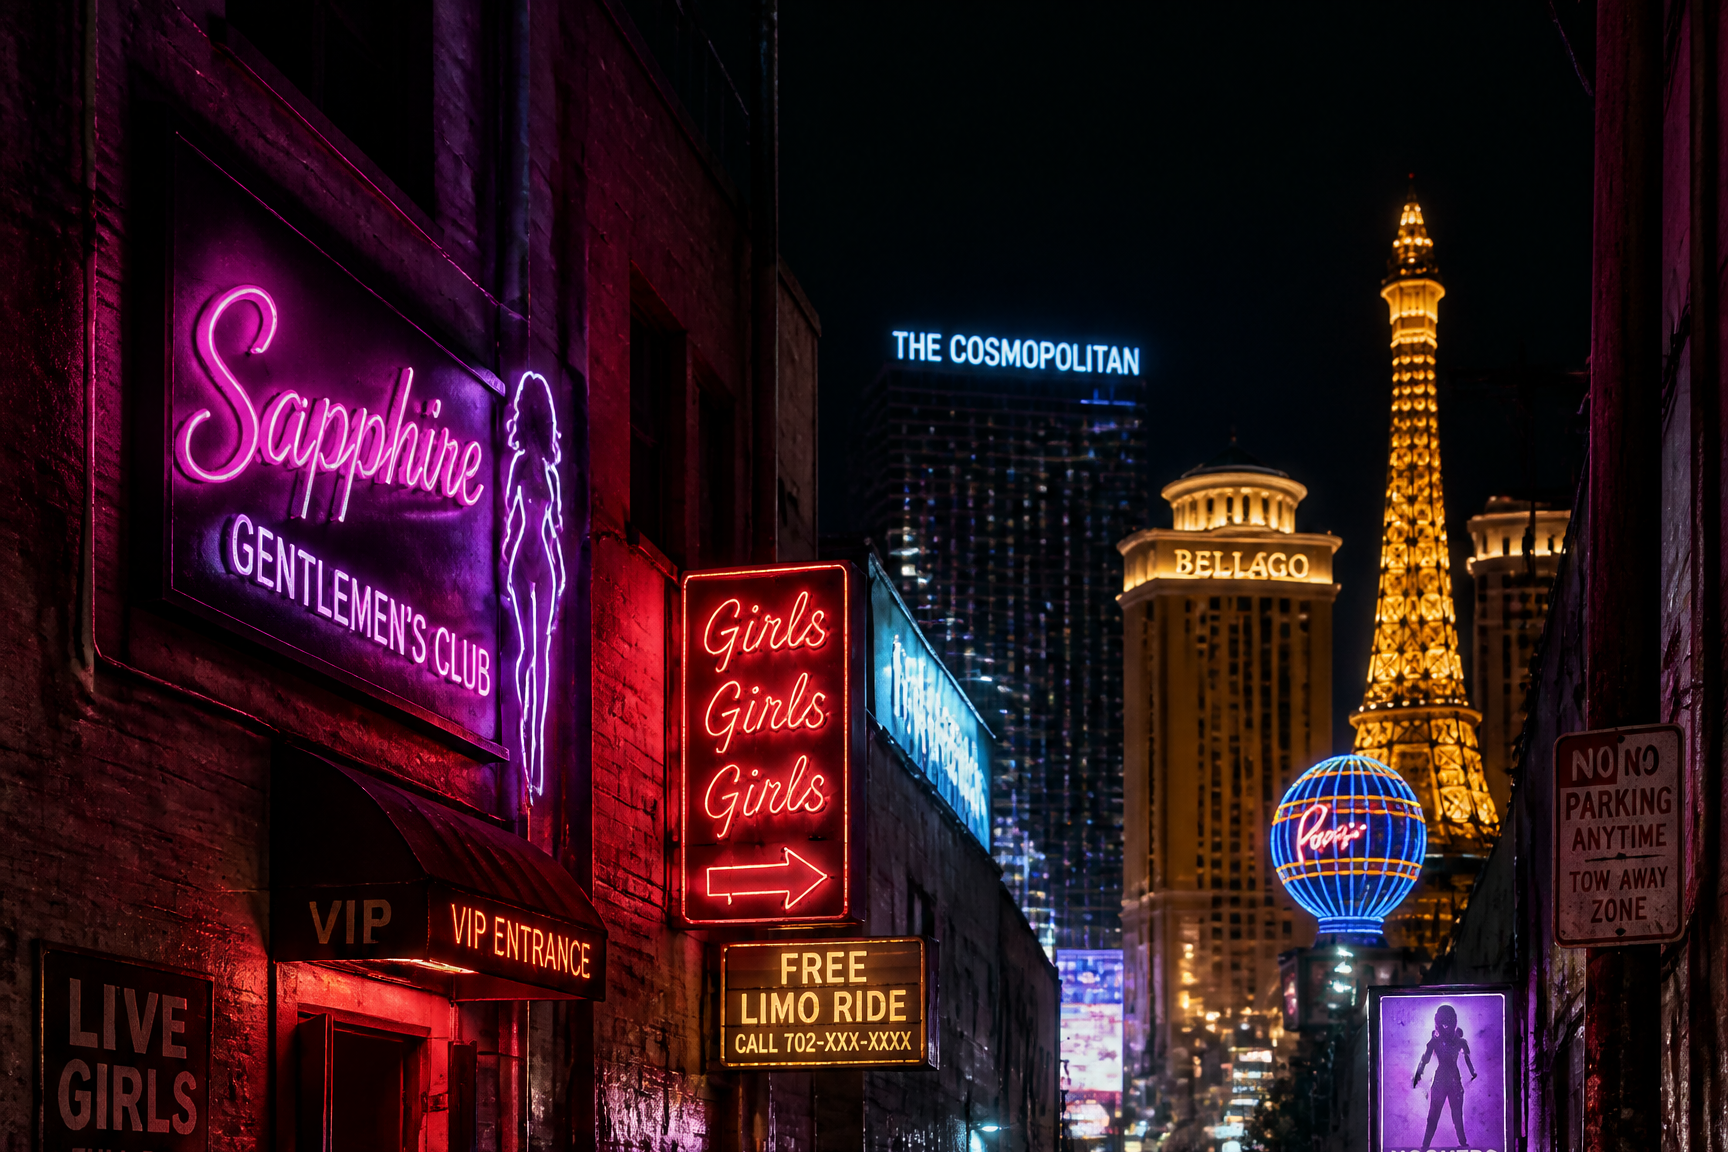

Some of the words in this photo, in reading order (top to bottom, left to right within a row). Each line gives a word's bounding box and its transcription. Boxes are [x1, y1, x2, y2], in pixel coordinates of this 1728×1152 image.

[892, 330, 943, 362] THE
[950, 333, 1140, 376] COSMOPOLITAN
[175, 284, 484, 522] Sapphire
[230, 513, 427, 665] GENTLEMEN'S
[434, 626, 491, 697] CLUB
[704, 591, 827, 673] Girls
[704, 672, 827, 753] Girls
[1571, 745, 1615, 781] NO
[704, 755, 826, 838] Girls
[1565, 786, 1672, 821] PARKING
[1572, 823, 1667, 851] ANYTIME
[1569, 869, 1611, 893] TOW
[1619, 866, 1668, 890] AWAY
[309, 899, 392, 944] VIP
[1590, 896, 1648, 923] ZONE
[451, 903, 487, 949] VIP
[495, 916, 591, 979] ENTRANCE
[780, 950, 868, 985] FREE
[69, 977, 188, 1059] LIVE
[741, 991, 820, 1025] LIMO
[833, 989, 907, 1023] RIDE
[735, 1033, 779, 1054] CALL
[784, 1031, 912, 1053] 702-XXX-XXXX
[57, 1058, 198, 1136] GIRLS
